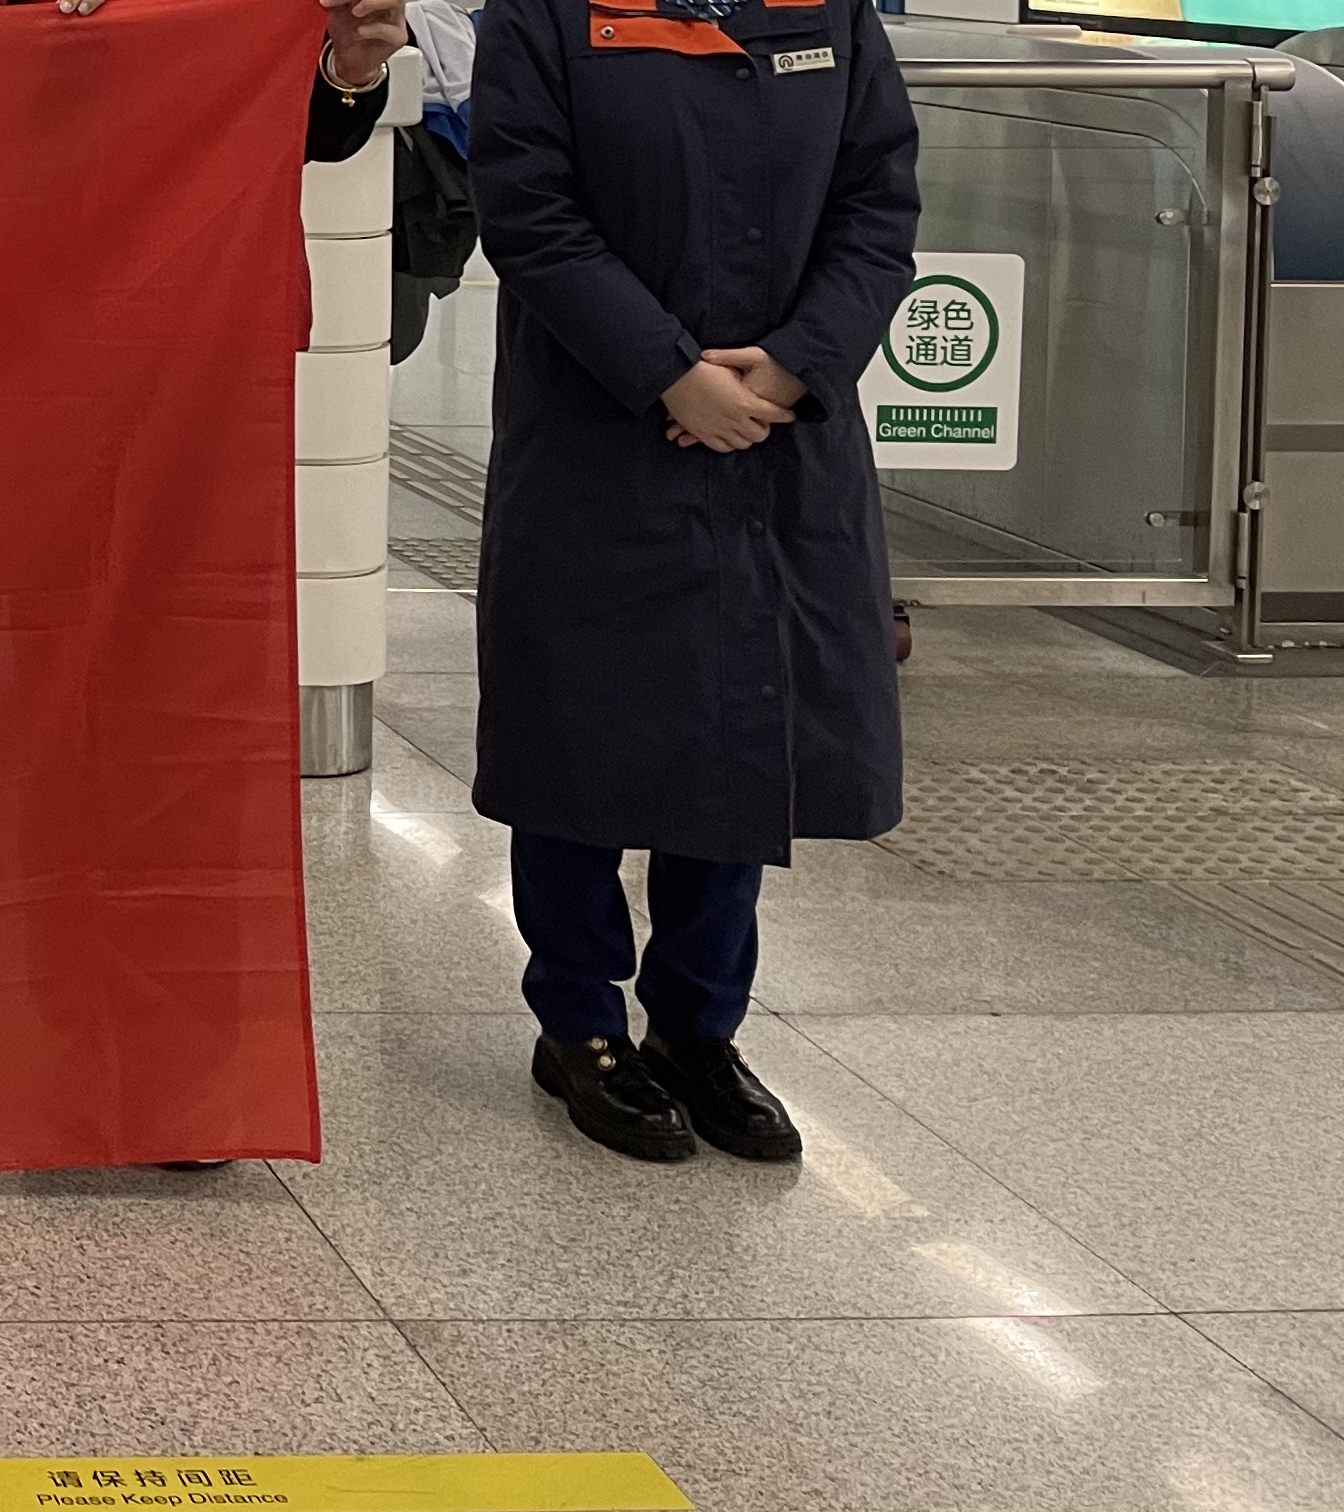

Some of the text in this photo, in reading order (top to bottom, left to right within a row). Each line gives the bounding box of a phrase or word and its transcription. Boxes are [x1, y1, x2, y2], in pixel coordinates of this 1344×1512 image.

[906, 298, 974, 331] 绿色
[905, 335, 974, 366] 通道
[878, 423, 995, 439] Green Channel
[46, 1468, 258, 1489] 请保持间距
[36, 1492, 289, 1508] Please Keep Distance
